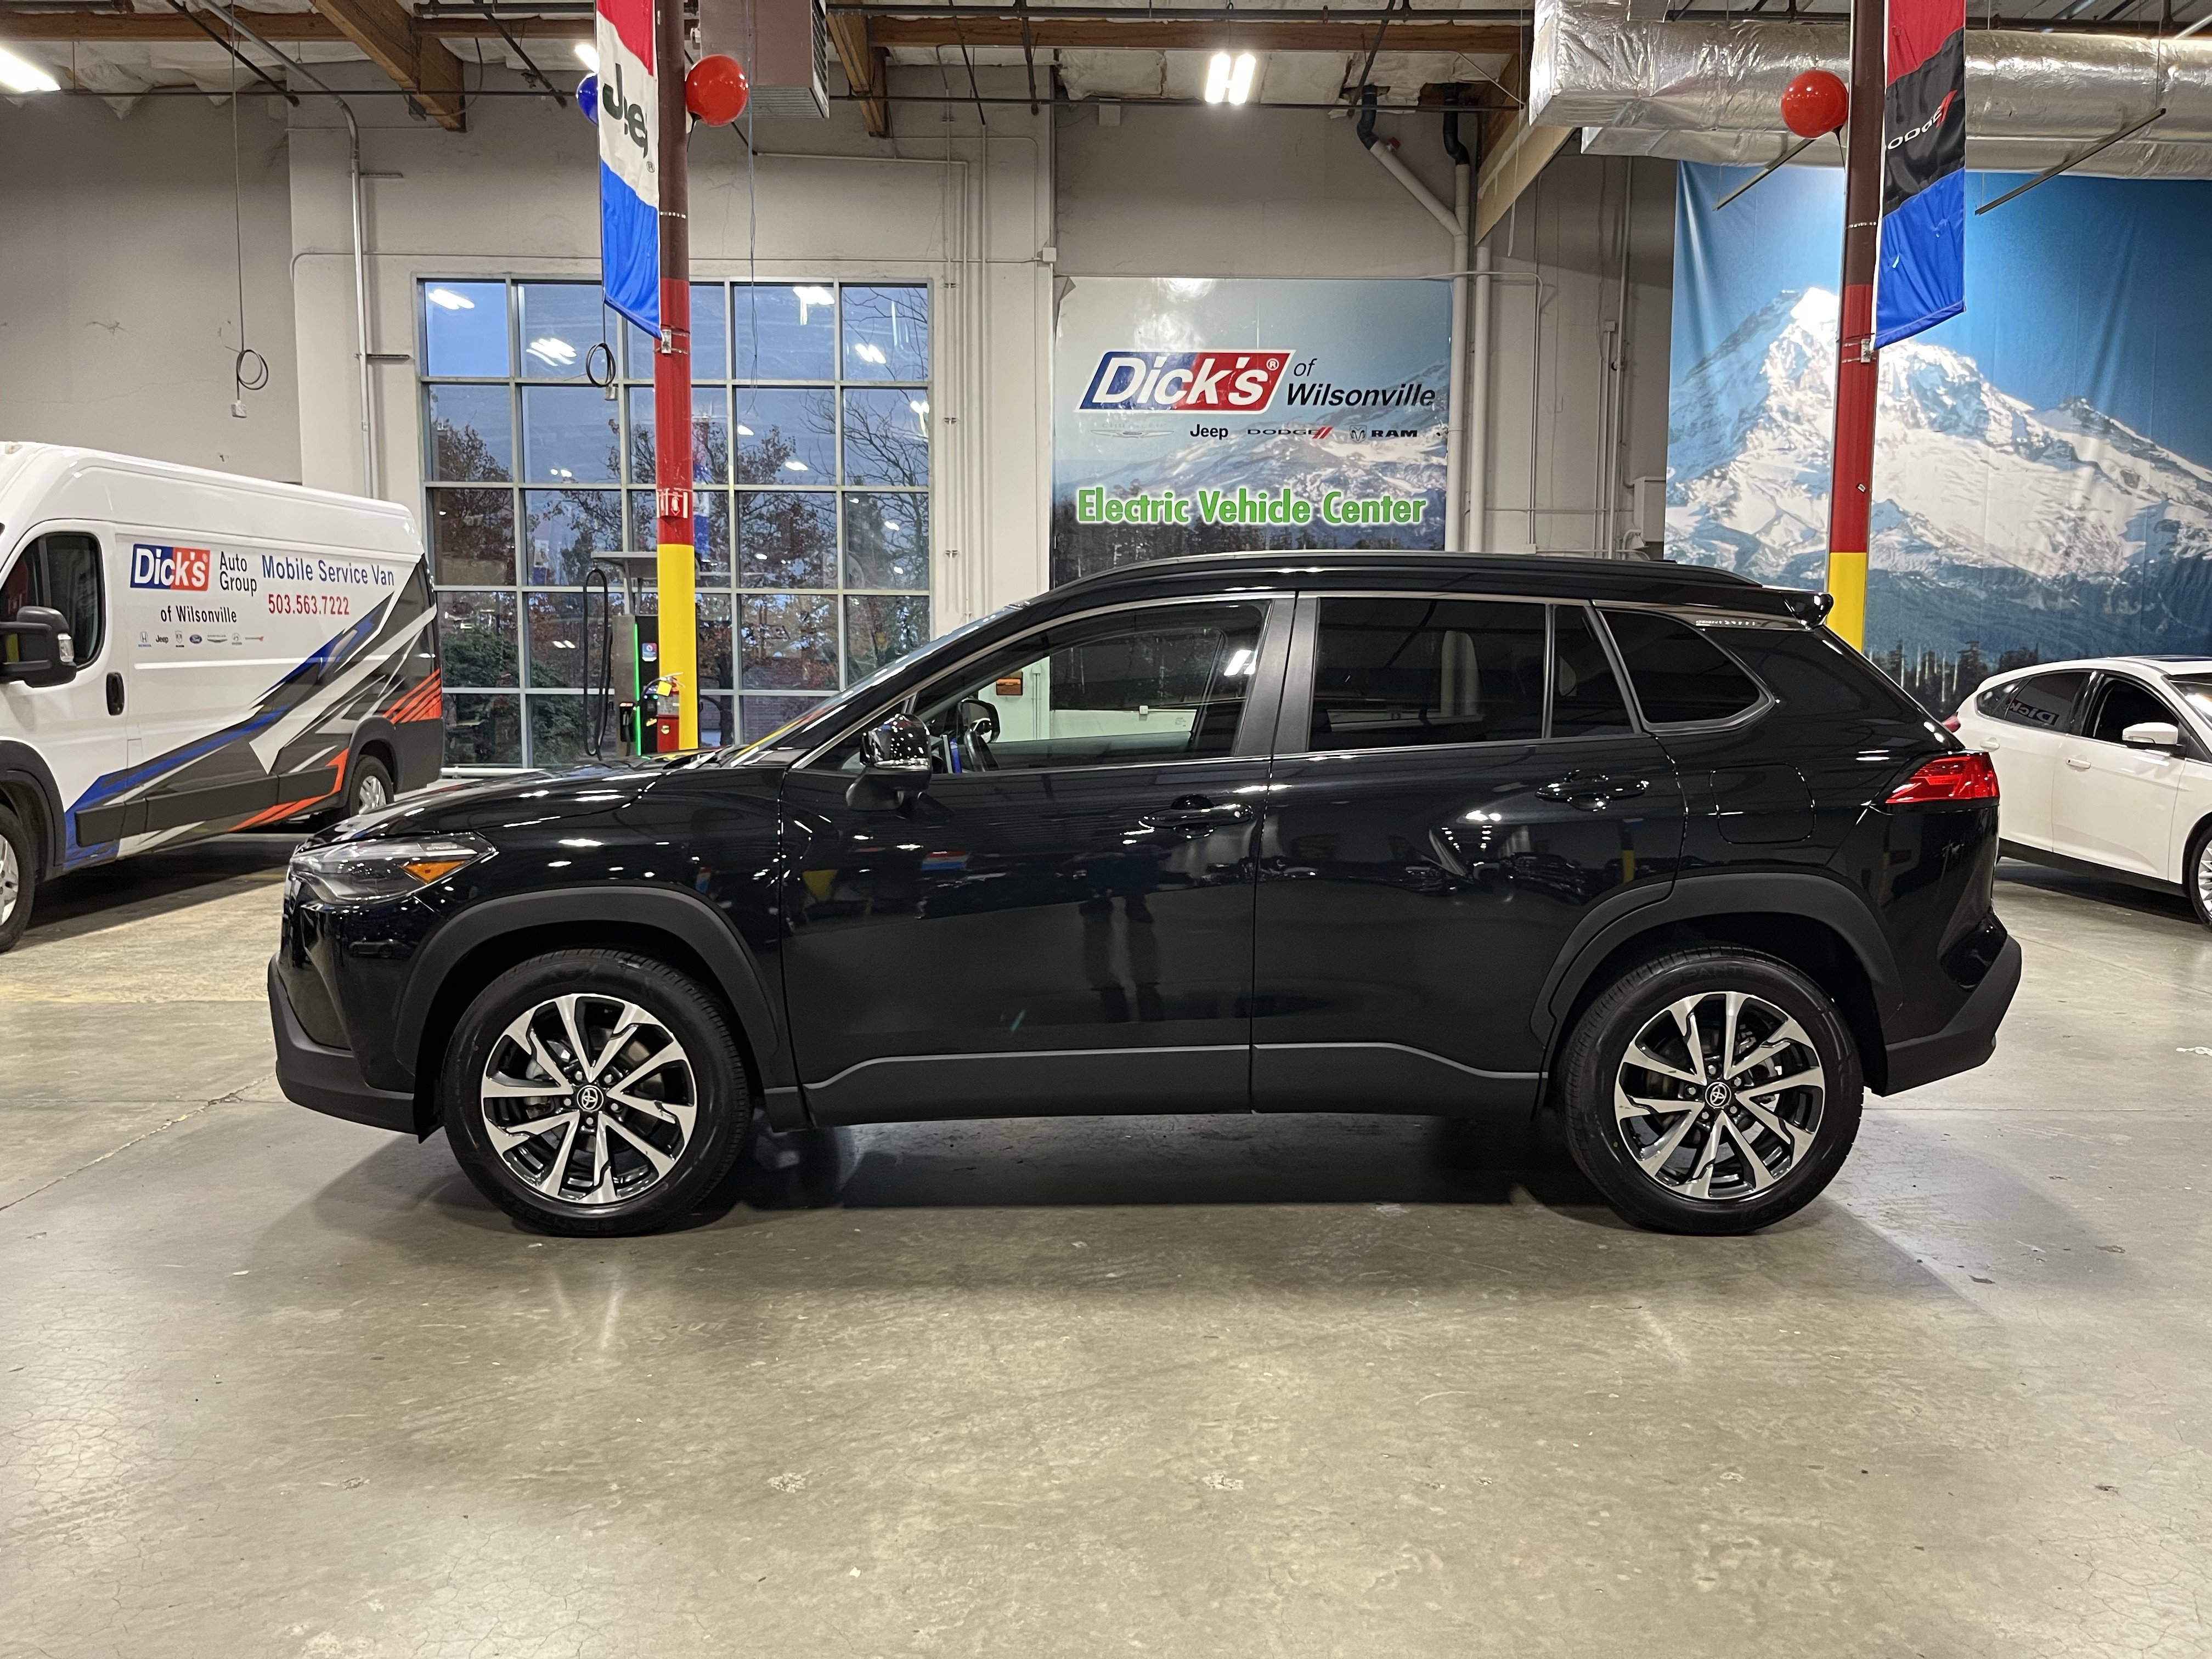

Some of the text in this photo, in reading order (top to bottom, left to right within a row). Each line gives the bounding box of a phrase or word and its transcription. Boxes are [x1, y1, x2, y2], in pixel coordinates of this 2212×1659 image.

[1092, 357, 1318, 405] Dick's of
[1287, 383, 1435, 406] Wilsonville
[1190, 424, 1228, 440] Jeep
[1079, 487, 1426, 523] Electric Vehicle Center
[134, 548, 206, 588] Dick's
[219, 551, 247, 572] Auto
[262, 555, 394, 586] Mobile Service Van
[219, 571, 257, 596] Group
[161, 605, 237, 623] of Wilsonville
[268, 594, 349, 615] 503.563.7222
[156, 635, 168, 644] Jeep
